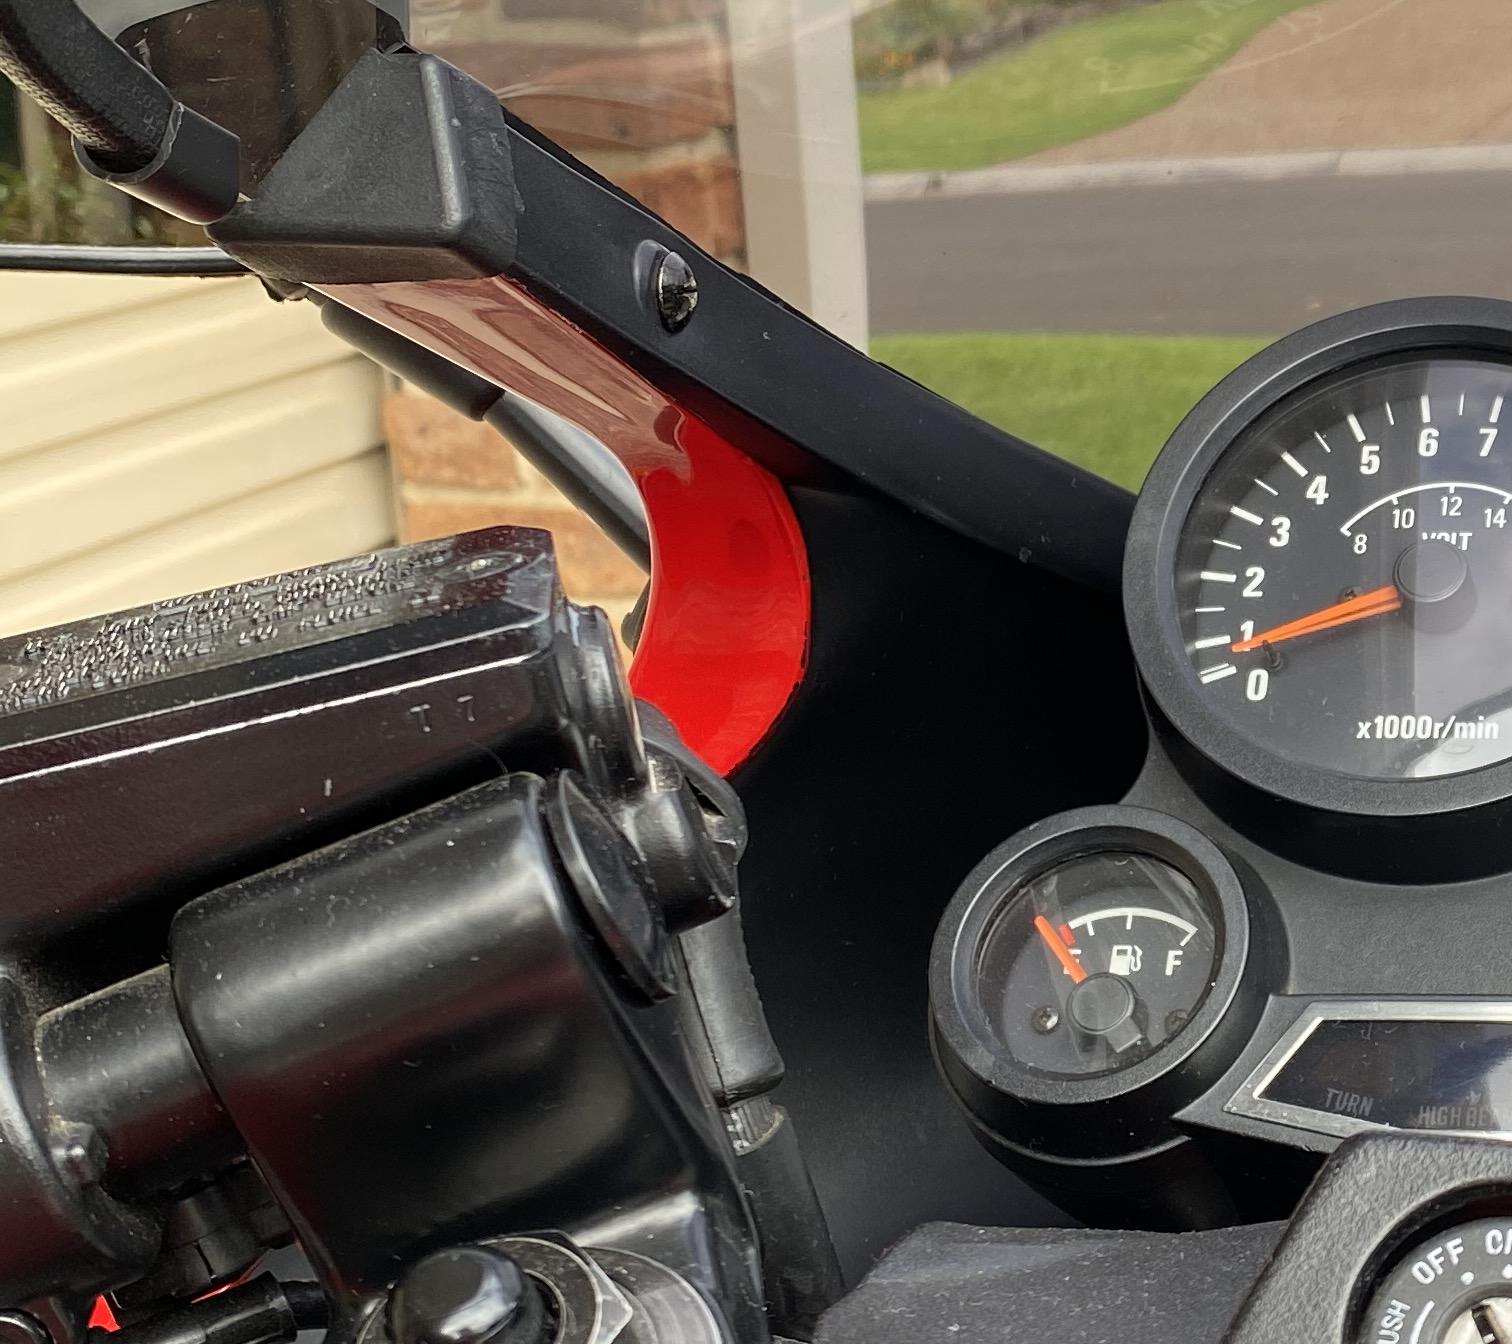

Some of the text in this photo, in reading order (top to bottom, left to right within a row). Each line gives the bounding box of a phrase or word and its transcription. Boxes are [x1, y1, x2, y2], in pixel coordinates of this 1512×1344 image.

[1417, 428, 1440, 456] 6
[1478, 428, 1498, 456] 7
[1360, 445, 1382, 474] 5
[1306, 475, 1329, 504] 4
[1392, 509, 1414, 528] 10
[1441, 496, 1462, 515] 12
[1484, 509, 1506, 527] 14
[1268, 516, 1290, 546] 3
[1353, 533, 1367, 554] 8
[1241, 567, 1265, 597] 2
[1240, 619, 1254, 652] 1
[1246, 668, 1269, 701] 0
[1356, 715, 1499, 740] x1000r/min
[1164, 950, 1184, 976] F
[1325, 1088, 1373, 1117] TURN
[1418, 1106, 1462, 1126] HIGH
[1411, 1238, 1464, 1285] OFF
